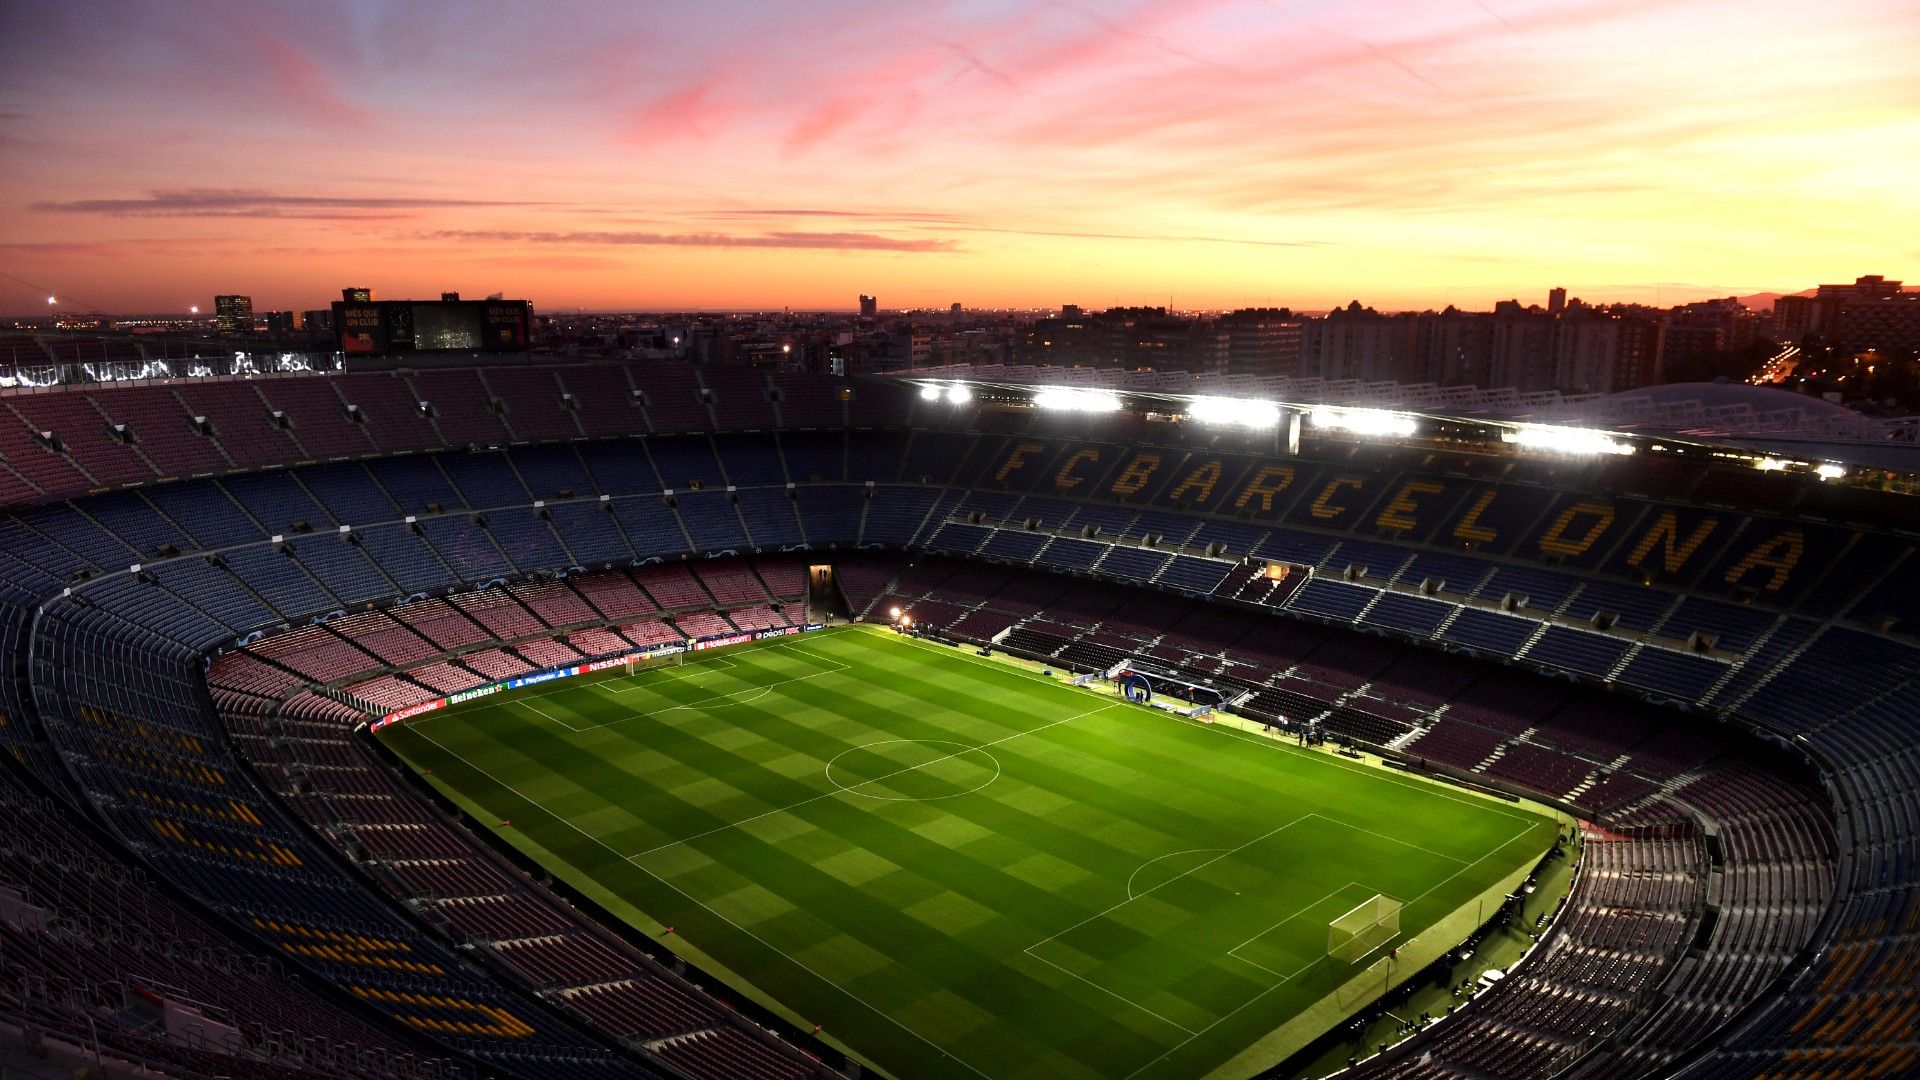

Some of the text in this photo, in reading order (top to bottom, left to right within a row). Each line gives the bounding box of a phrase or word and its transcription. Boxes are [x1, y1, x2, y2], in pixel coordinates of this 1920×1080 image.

[363, 307, 378, 318] QUE
[346, 318, 378, 327] UN CLUB
[995, 442, 1801, 590] FC BARCELONA
[763, 628, 784, 639] pepsi
[707, 636, 746, 649] Hotels.com
[589, 656, 627, 672] NISSAN
[525, 672, 556, 684] PlayStation
[451, 687, 495, 704] Heineken
[398, 702, 438, 720] Santander
